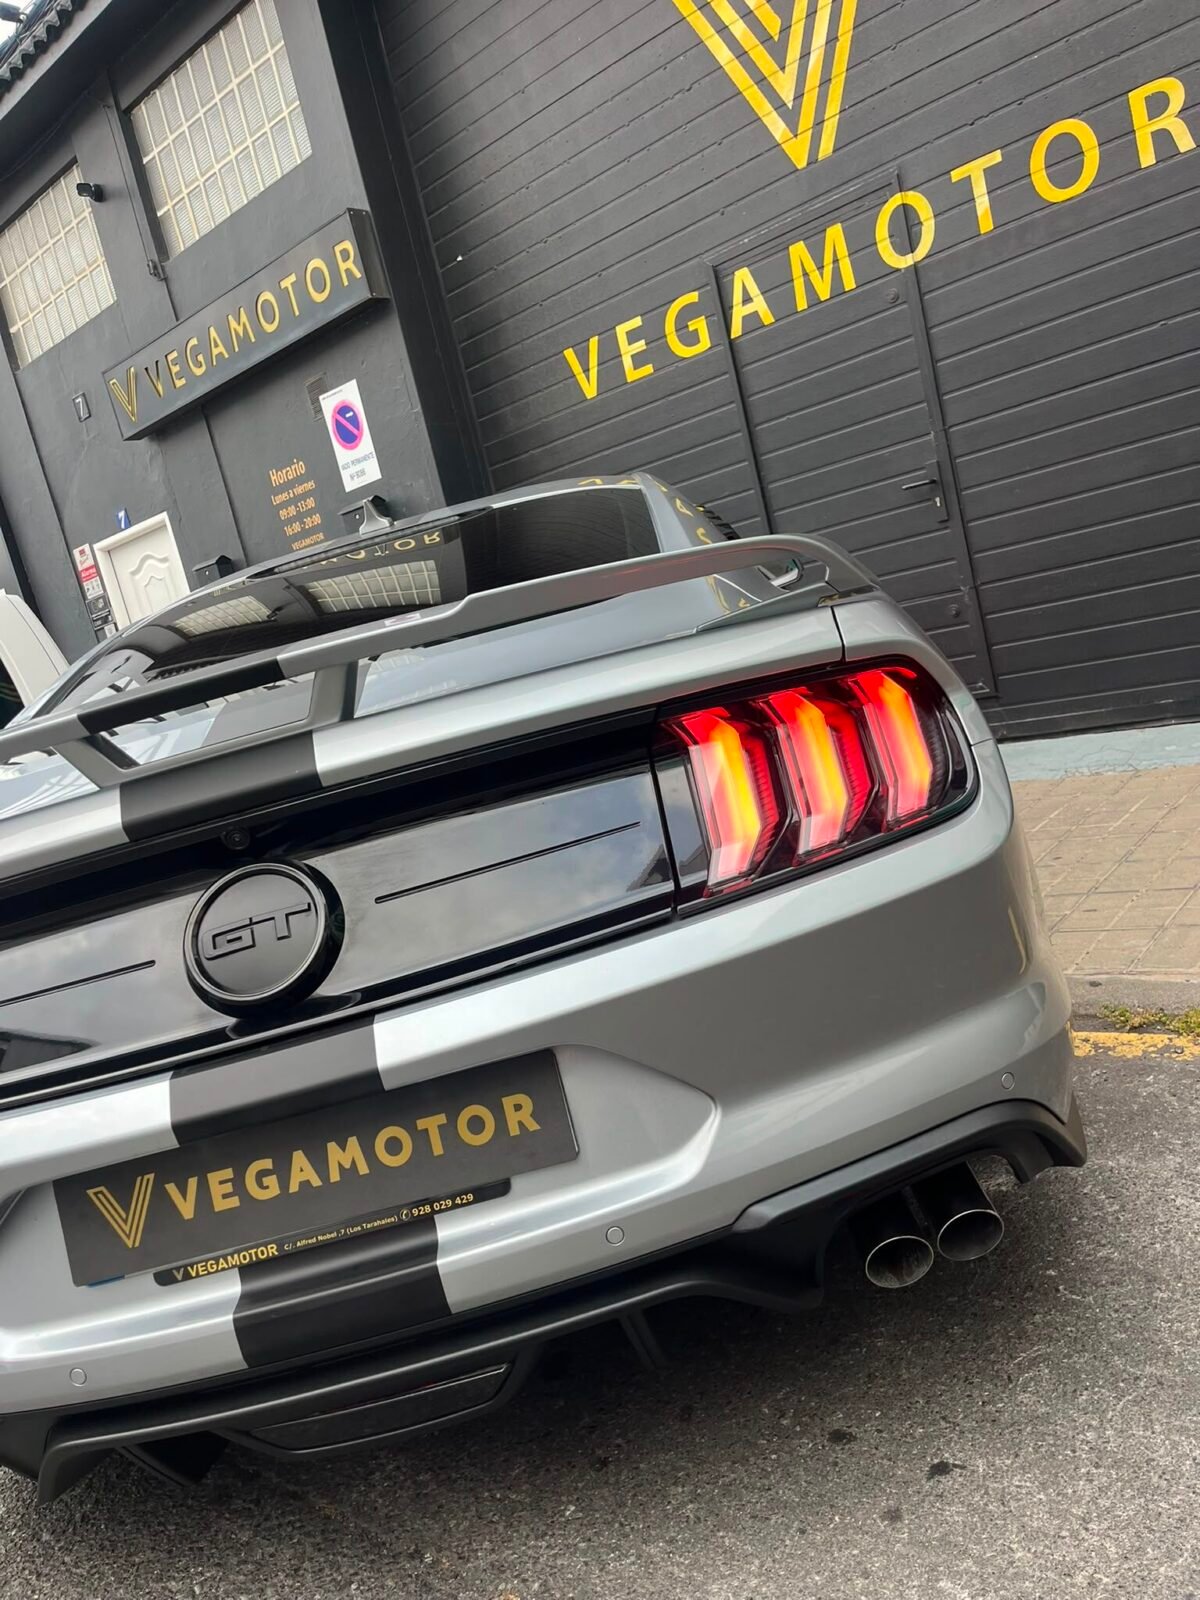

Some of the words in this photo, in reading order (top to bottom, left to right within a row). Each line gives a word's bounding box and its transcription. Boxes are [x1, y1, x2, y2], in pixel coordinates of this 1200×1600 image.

[563, 77, 1197, 400] VEGAMOTOR
[144, 239, 362, 399] VEGAMOTOR
[269, 458, 306, 487] Horario
[289, 489, 294, 498] a
[293, 480, 316, 496] viernes
[118, 509, 126, 529] 7
[284, 521, 301, 536] 16:00
[304, 513, 321, 529] 20:00
[202, 902, 311, 961] GT
[164, 1093, 541, 1220] VEGAMOTOR
[187, 1243, 279, 1277] VEGAMOTOR
[296, 1236, 317, 1247] Alfred
[317, 1231, 338, 1242] Nobel
[346, 1225, 362, 1235] (Los
[362, 1215, 398, 1231] Tarahales)
[412, 1204, 431, 1217] 928
[433, 1199, 453, 1211] 029
[454, 1193, 474, 1205] 429
